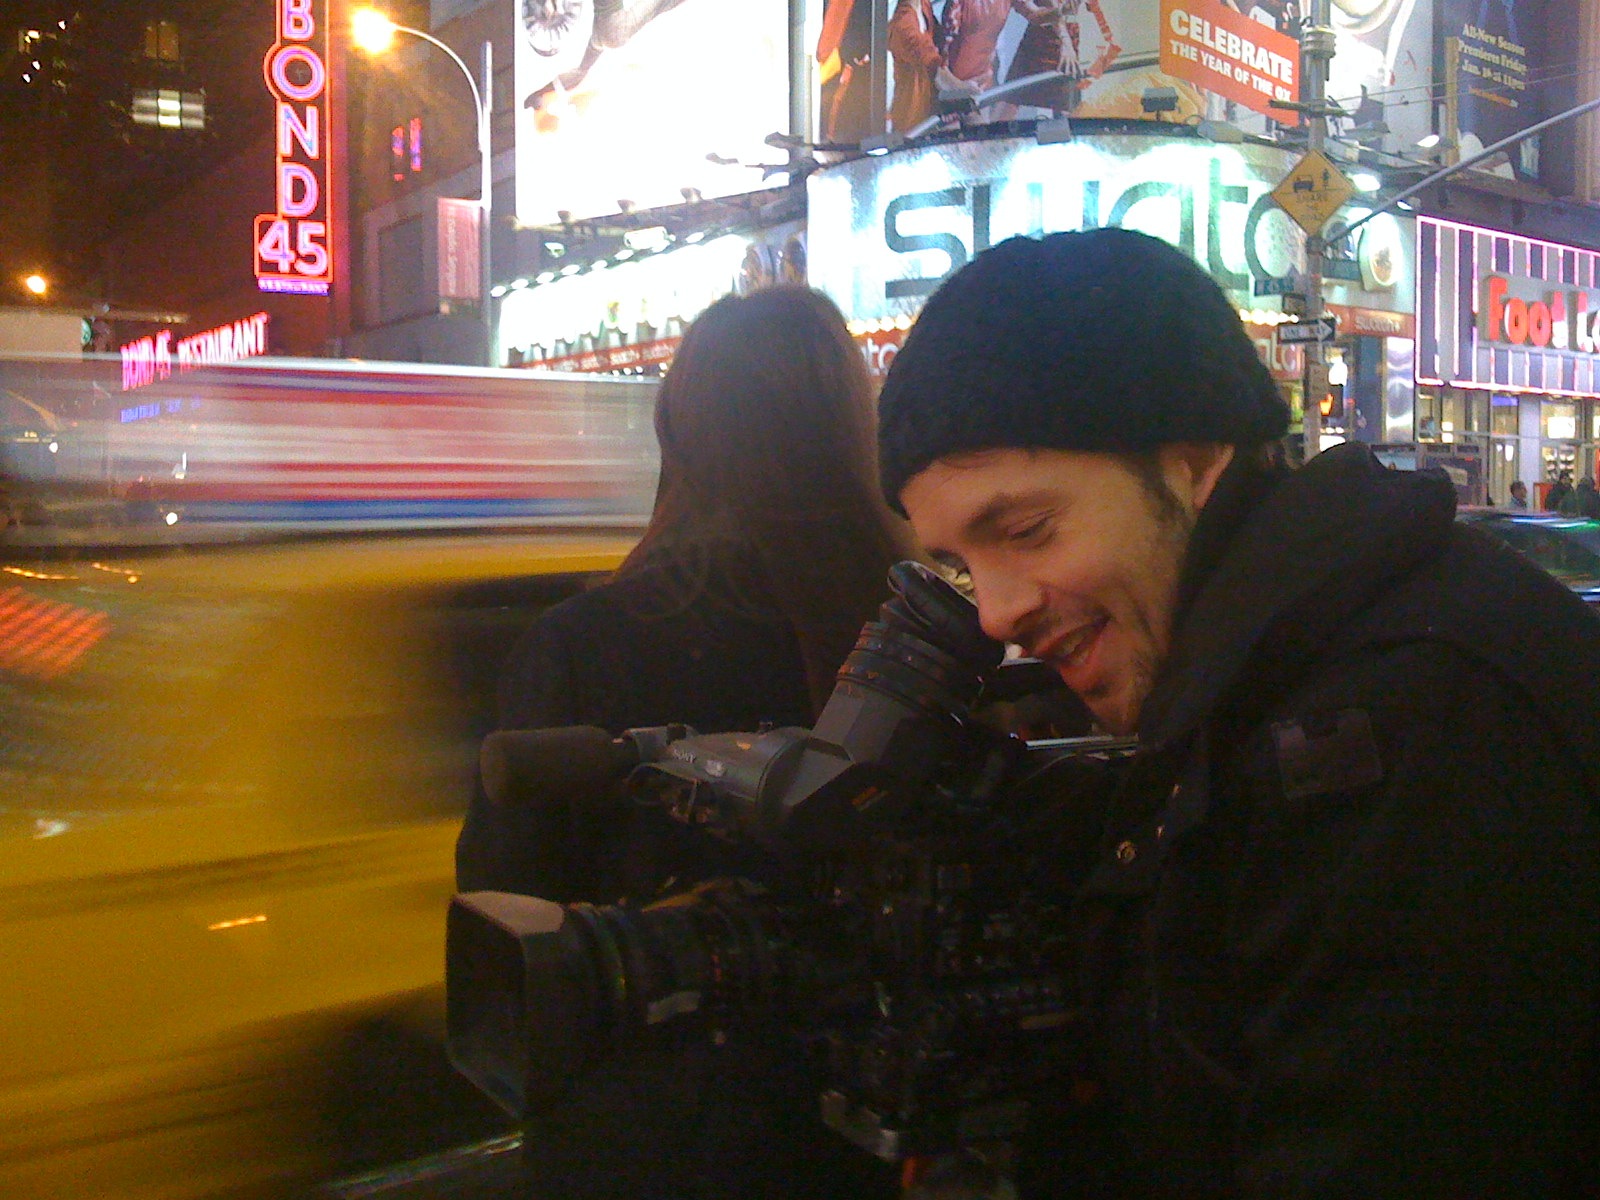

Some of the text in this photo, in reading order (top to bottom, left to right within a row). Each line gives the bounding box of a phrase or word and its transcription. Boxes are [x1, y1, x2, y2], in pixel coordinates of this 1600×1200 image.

[1169, 39, 1293, 103] THE YEAR OF THE OX
[1170, 9, 1293, 85] CELEBRATE
[271, 0, 325, 218] BOND
[258, 219, 328, 276] 45
[1488, 275, 1569, 349] Foot
